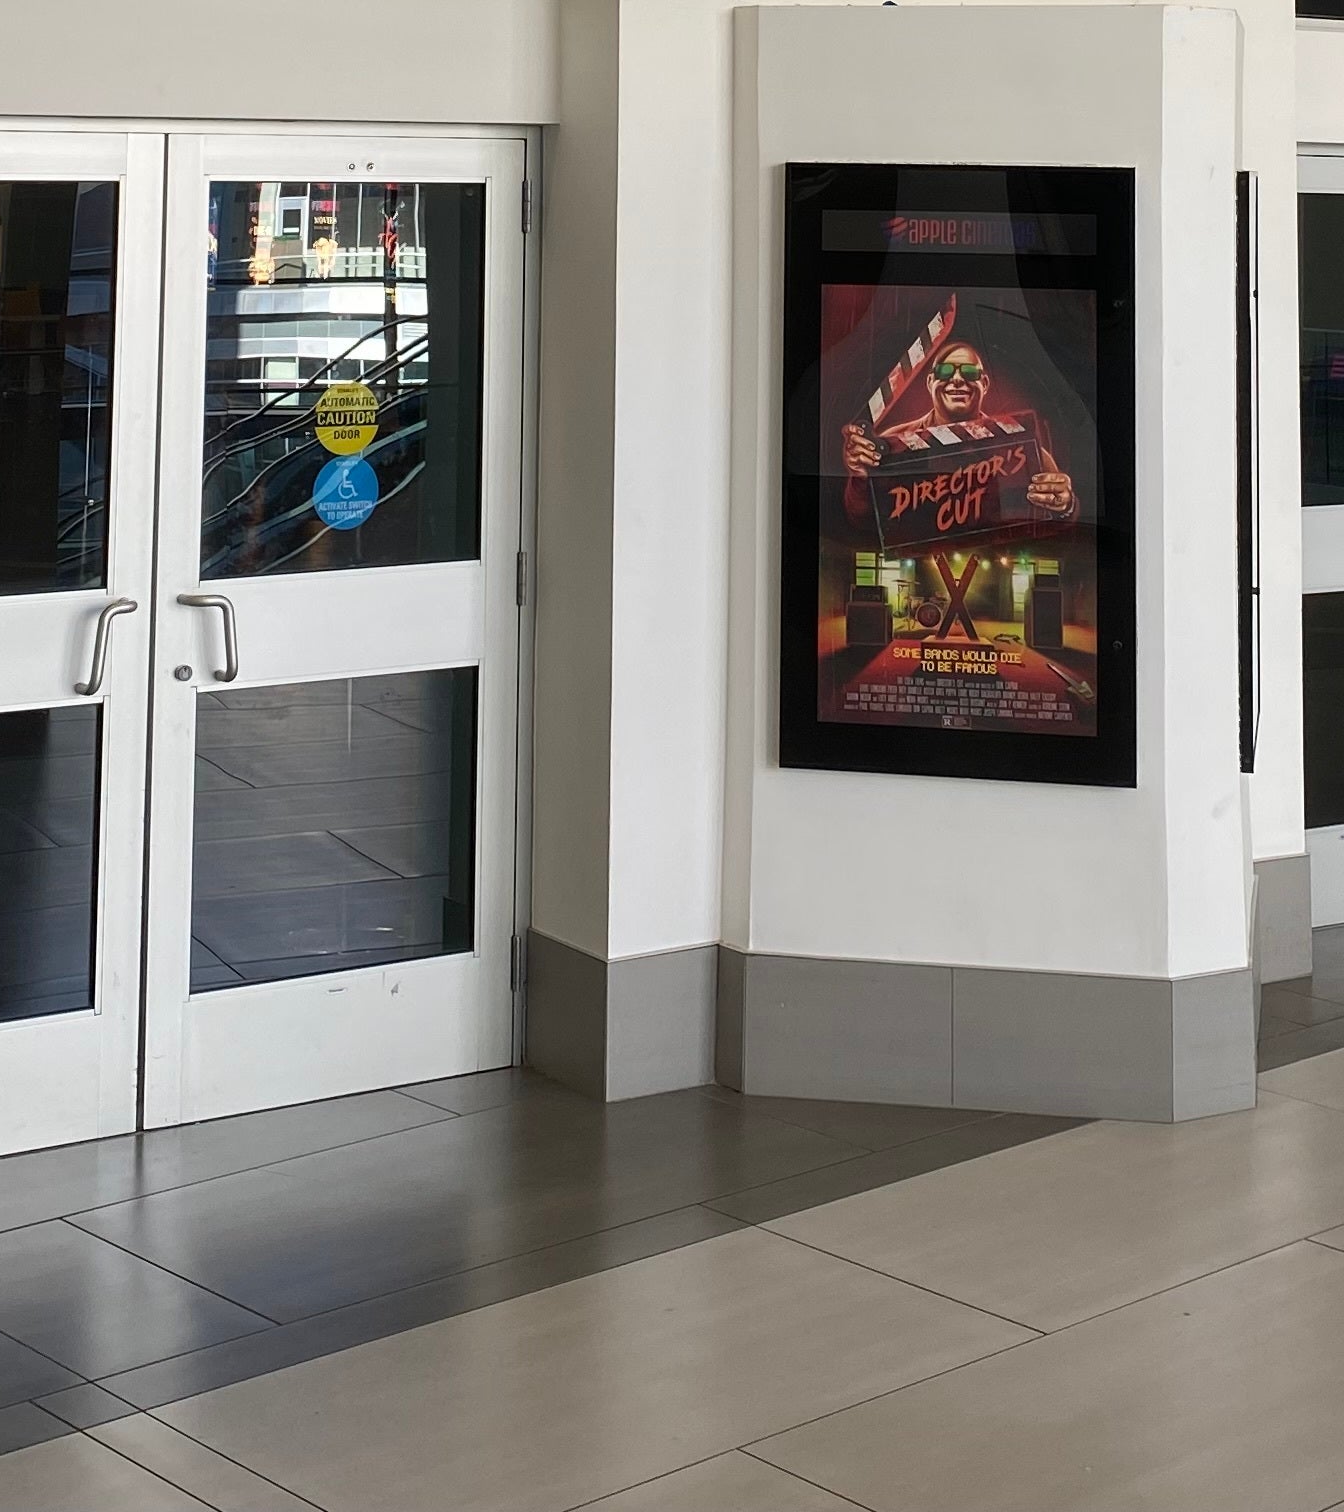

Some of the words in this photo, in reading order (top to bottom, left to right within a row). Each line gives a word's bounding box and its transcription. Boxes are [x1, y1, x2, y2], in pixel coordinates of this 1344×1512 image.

[320, 397, 375, 408] AUTOMATIC
[317, 411, 376, 425] CAUTION
[333, 430, 360, 440] DOOR
[888, 445, 1027, 520] DIRECTOR'S
[318, 502, 348, 512] ACTIVATE
[348, 500, 373, 511] SWITCH
[937, 487, 987, 532] CUT
[327, 511, 336, 521] TO
[336, 509, 364, 520] OPERATE
[893, 648, 921, 659] SOME
[924, 649, 959, 661] BANDS
[962, 650, 997, 663] WOULD
[1000, 652, 1022, 664] DIE
[920, 661, 935, 672] TO
[937, 662, 952, 673] BE
[955, 662, 998, 675] FAMOUS
